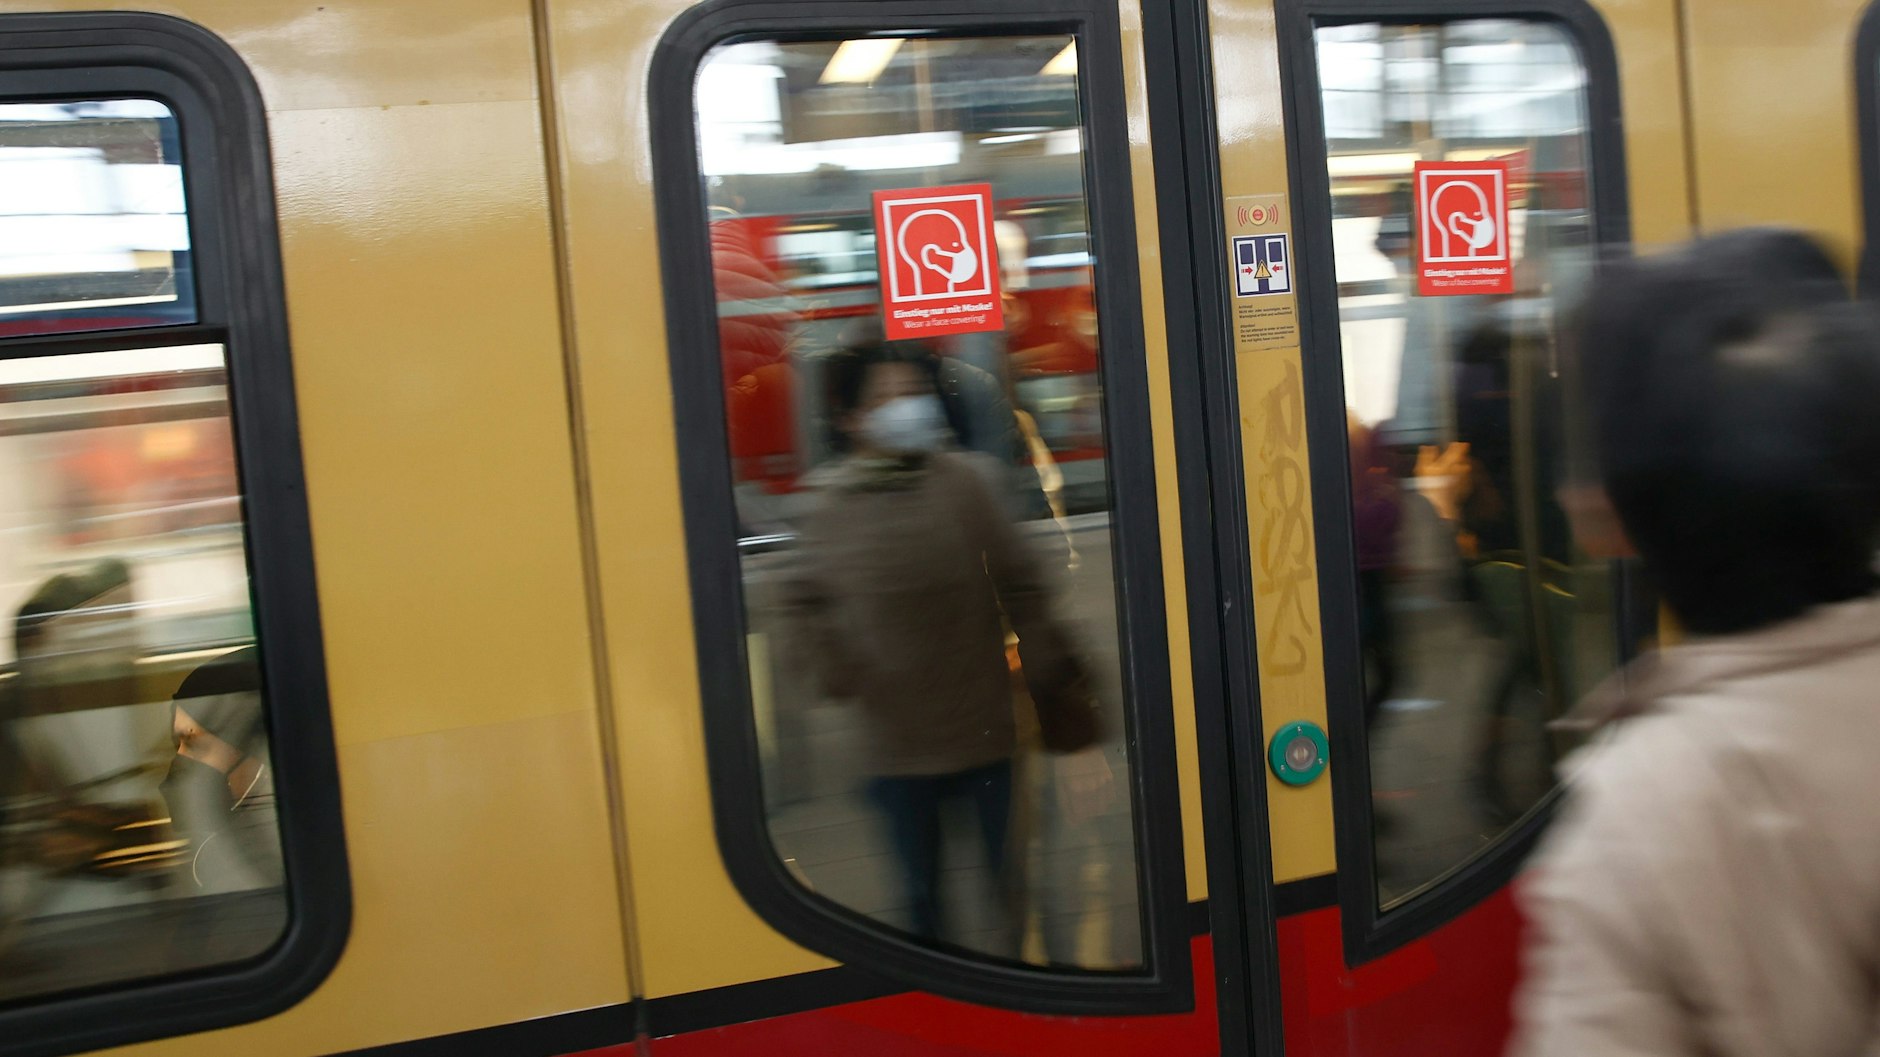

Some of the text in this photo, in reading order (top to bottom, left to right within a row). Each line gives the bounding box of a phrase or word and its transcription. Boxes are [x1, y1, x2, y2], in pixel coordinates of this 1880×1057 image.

[893, 302, 994, 318] Einstieg nur mit Maske!
[903, 321, 924, 329] Wear
[931, 318, 949, 326] face
[950, 314, 986, 324] covering!
